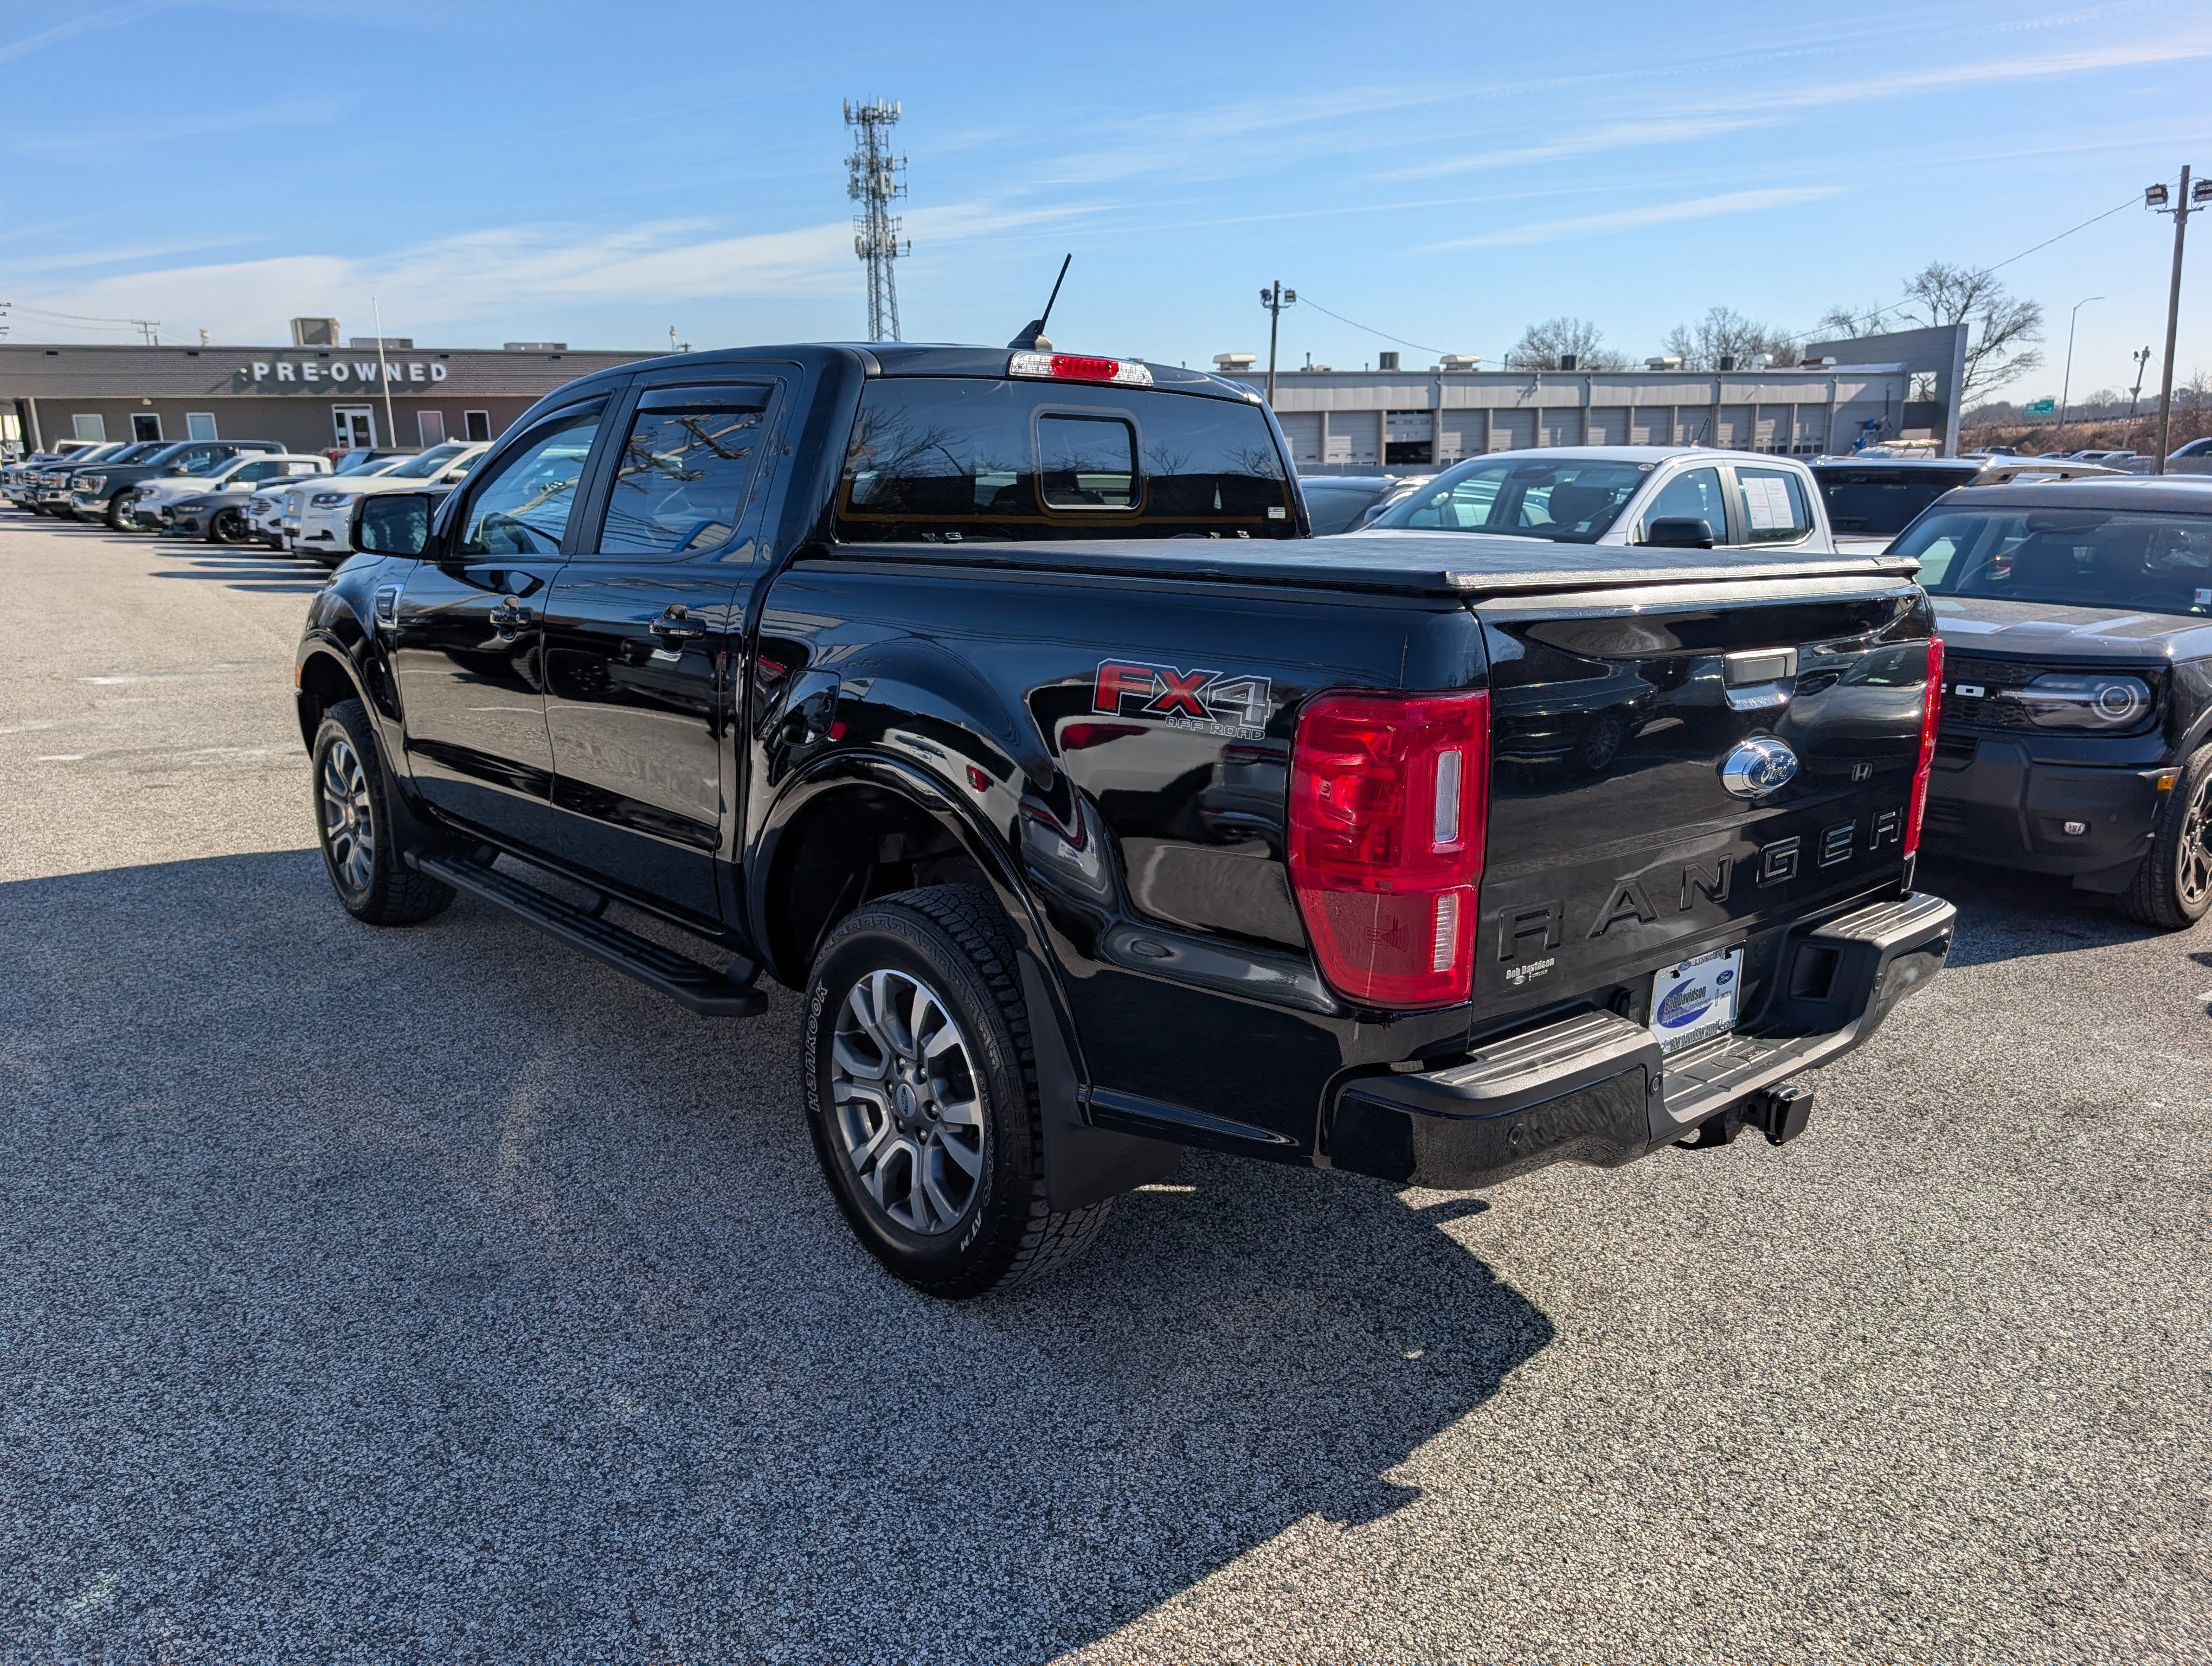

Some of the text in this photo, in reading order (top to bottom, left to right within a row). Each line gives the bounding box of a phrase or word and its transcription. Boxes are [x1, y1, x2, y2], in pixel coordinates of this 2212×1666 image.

[253, 362, 447, 381] PRE-OWNED
[1091, 658, 1272, 729] FX4
[1165, 716, 1265, 741] OFF ROAD
[1497, 806, 1903, 962] RANGER
[1506, 958, 1554, 979] Bob Davidson
[1664, 993, 1679, 1012] Bob
[1679, 986, 1707, 1006] Davidson
